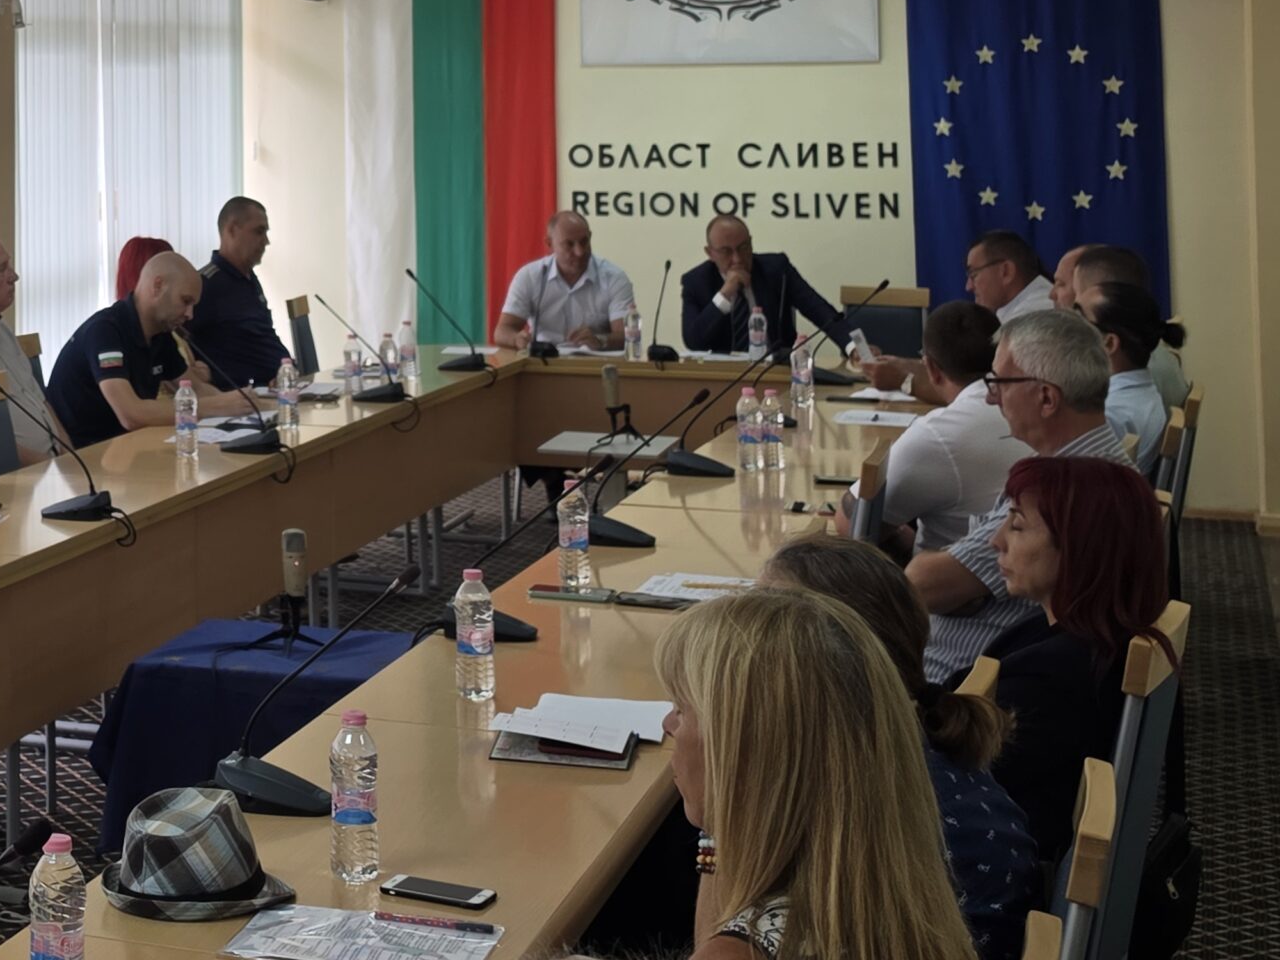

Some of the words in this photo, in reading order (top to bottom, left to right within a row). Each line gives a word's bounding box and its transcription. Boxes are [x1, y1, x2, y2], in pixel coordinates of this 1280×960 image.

[568, 142, 711, 169] ОБЛАСТ
[737, 142, 898, 169] СЛИВЕН
[571, 191, 699, 217] REGION
[712, 191, 757, 218] OF
[770, 192, 900, 219] SLIVEN
